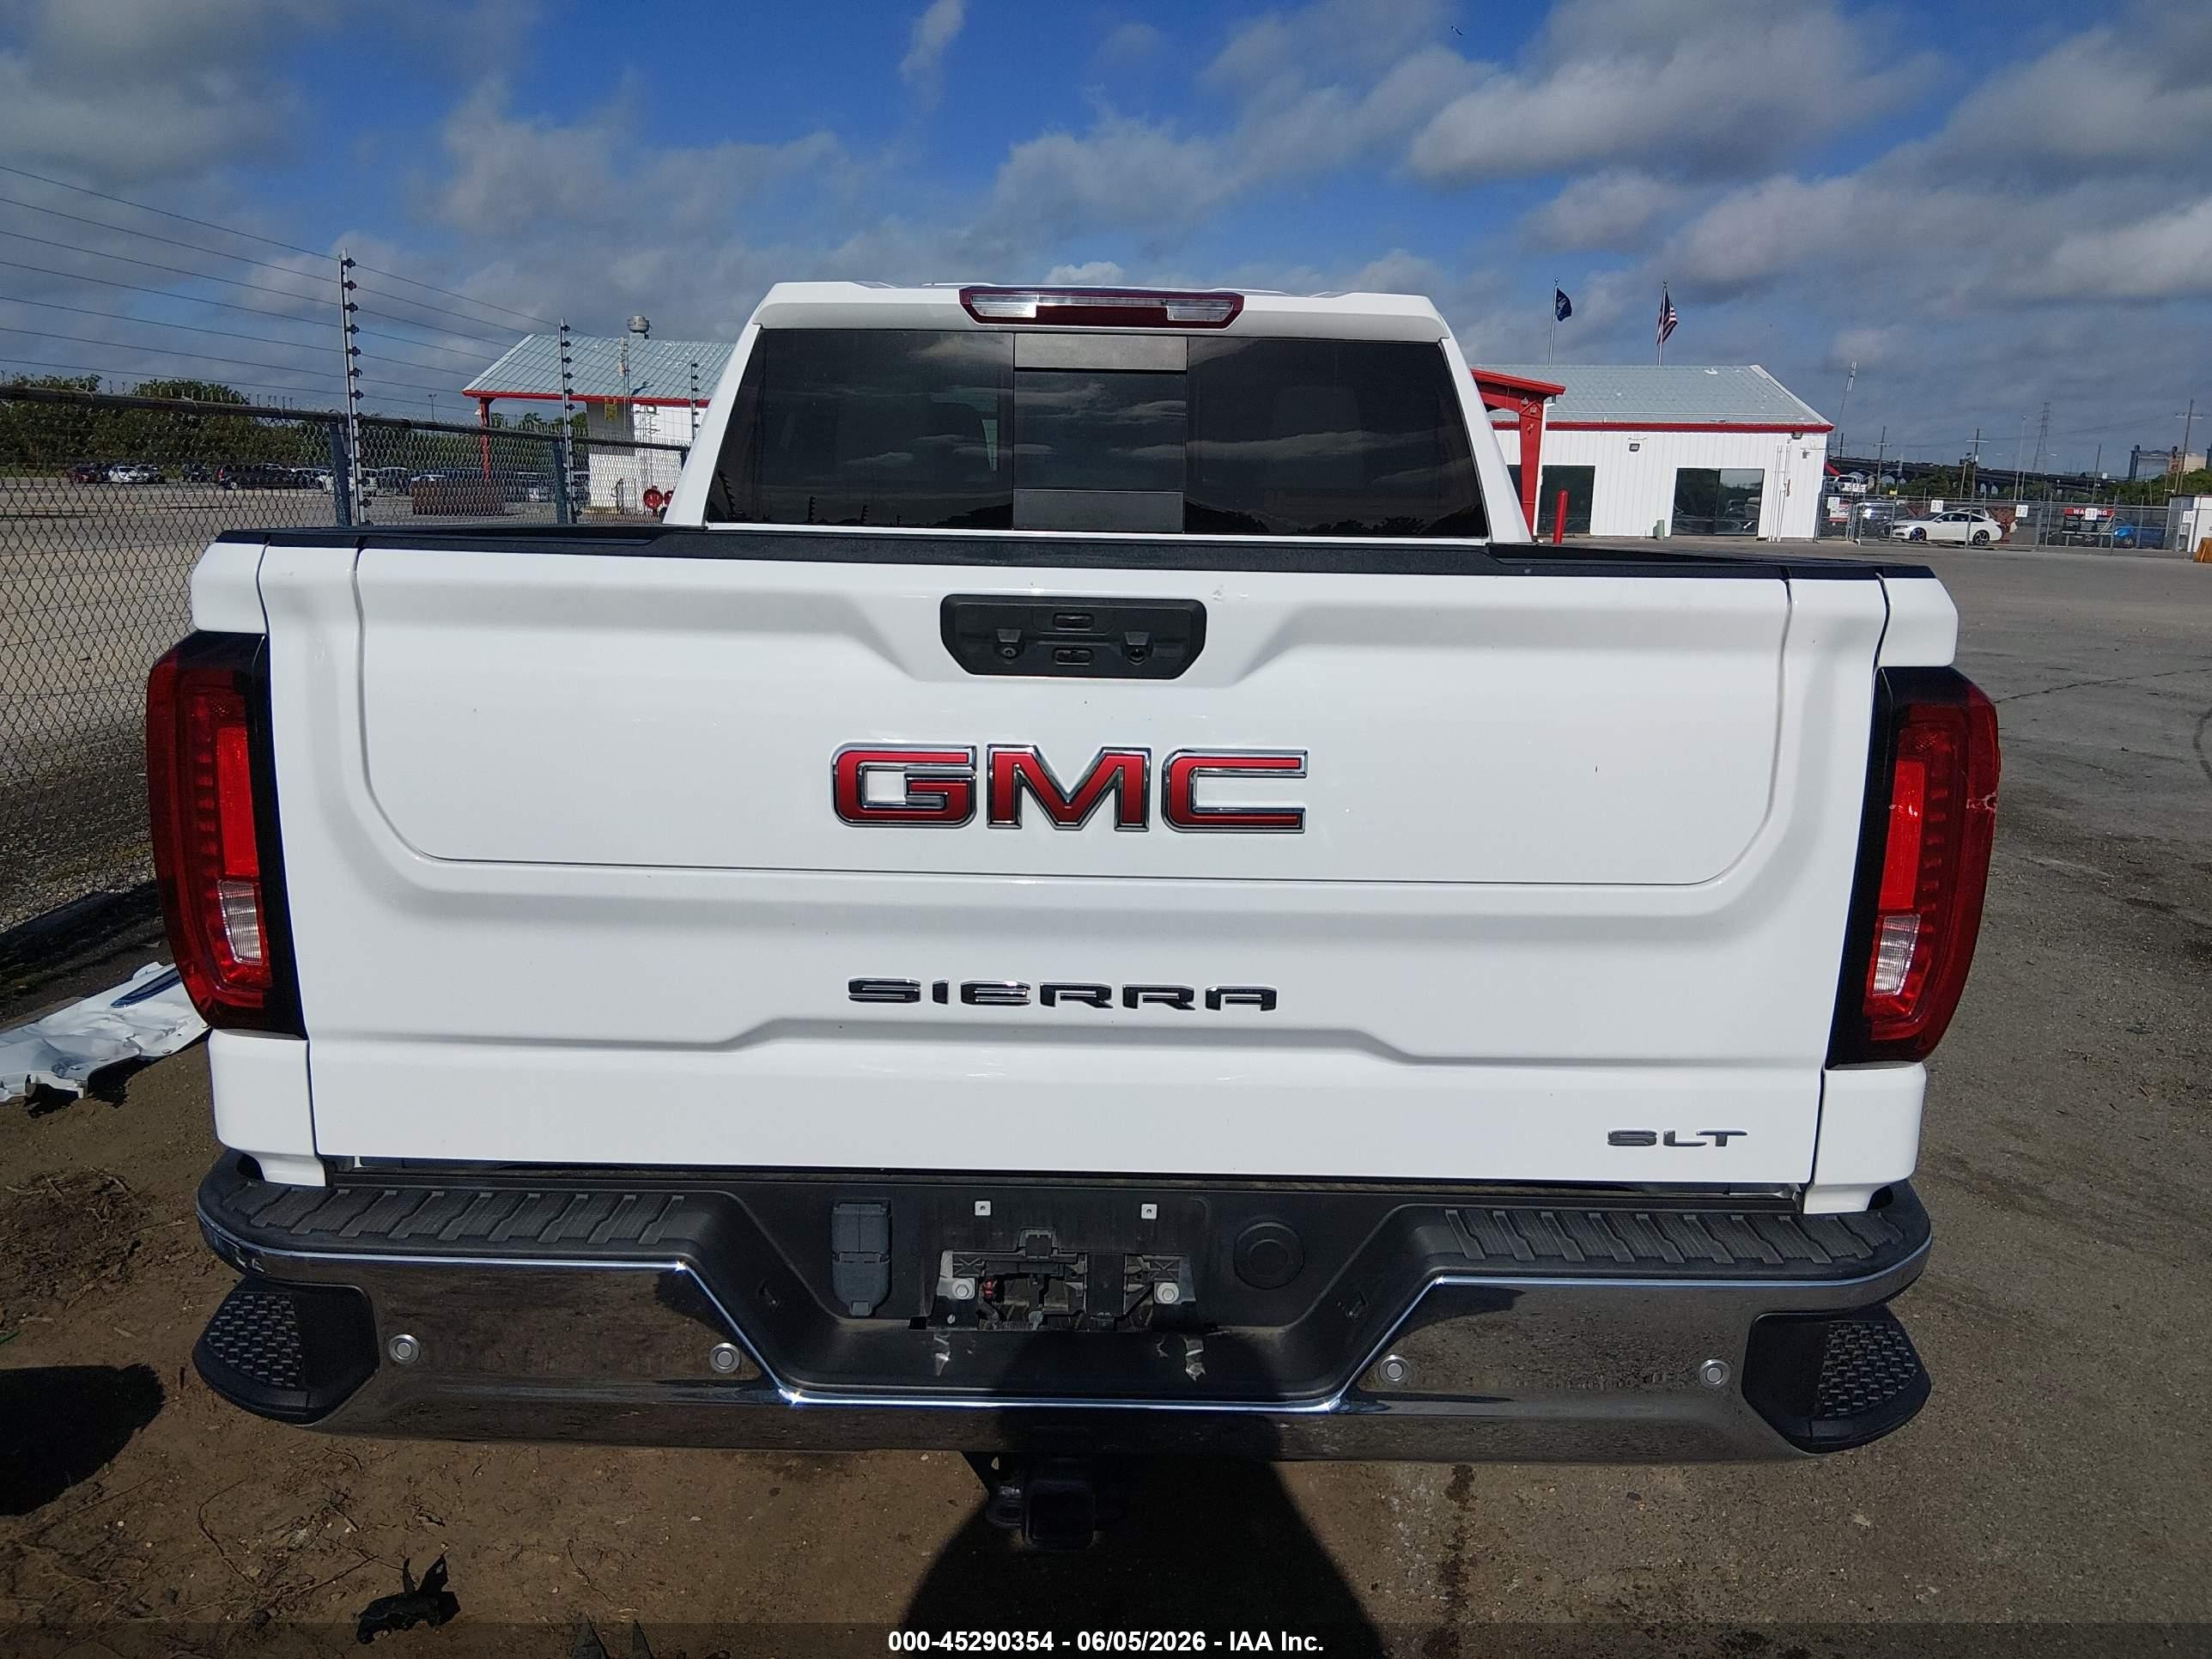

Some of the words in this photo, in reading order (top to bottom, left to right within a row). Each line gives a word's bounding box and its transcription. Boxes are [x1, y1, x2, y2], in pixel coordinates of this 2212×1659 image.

[2184, 513, 2194, 521] 30
[832, 743, 1307, 834] GMC
[848, 977, 1278, 1012] SIERRA
[1607, 1128, 1748, 1148] SLT
